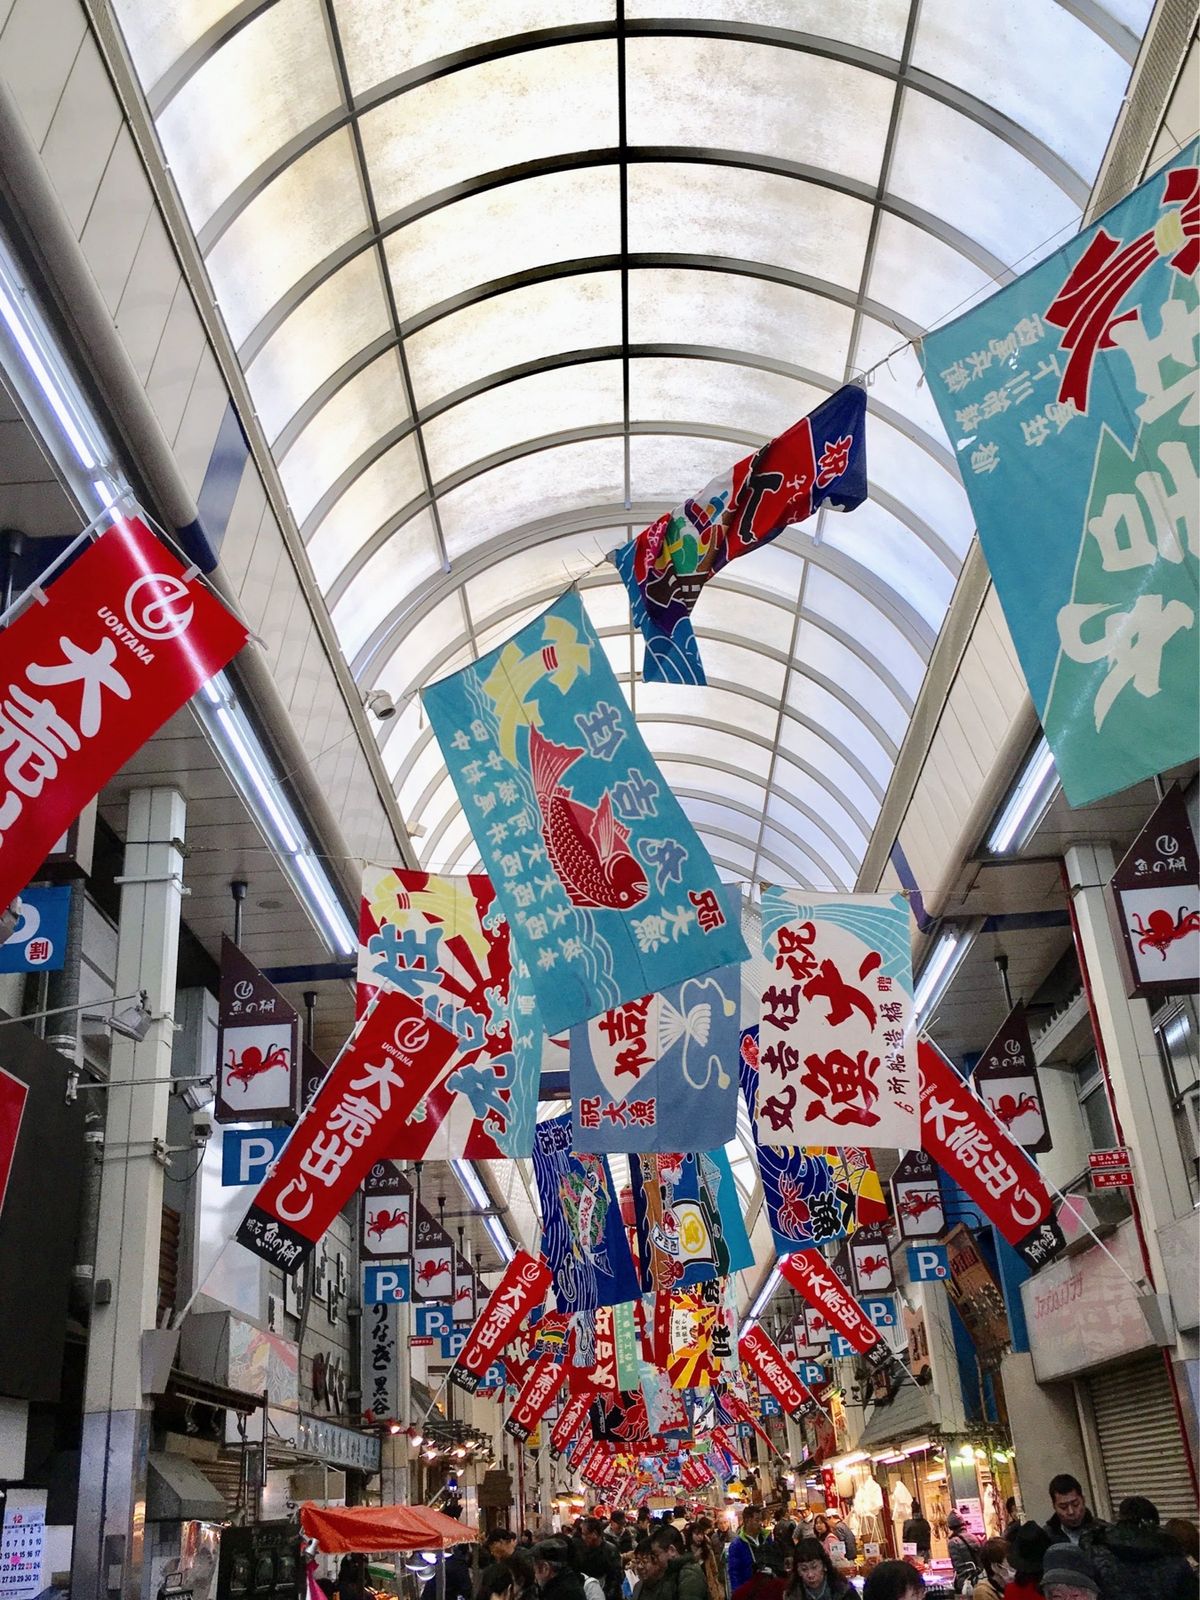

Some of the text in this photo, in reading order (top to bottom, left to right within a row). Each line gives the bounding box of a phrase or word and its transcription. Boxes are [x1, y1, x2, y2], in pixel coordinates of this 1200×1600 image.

[96, 605, 156, 666] UONTANA
[1134, 856, 1188, 875] 魚の棚
[28, 940, 50, 961] 割
[775, 921, 818, 981] 祝
[229, 999, 276, 1016] 魚の棚
[800, 951, 882, 1128] 大漁
[381, 1041, 414, 1068] UONTANA
[580, 1094, 657, 1129] 祝大漁
[275, 1056, 405, 1223] 大売出し
[239, 1137, 275, 1182] P
[917, 1252, 938, 1279] P
[376, 1272, 399, 1300] P
[425, 1311, 445, 1336] P
[869, 1302, 885, 1322] P
[466, 1283, 527, 1369] 大売出し
[449, 1333, 466, 1357] P
[838, 1336, 850, 1355] P
[485, 1367, 500, 1386] P
[806, 1366, 818, 1382] P
[371, 1377, 391, 1415] 黒谷
[517, 1361, 562, 1424] 大売出し
